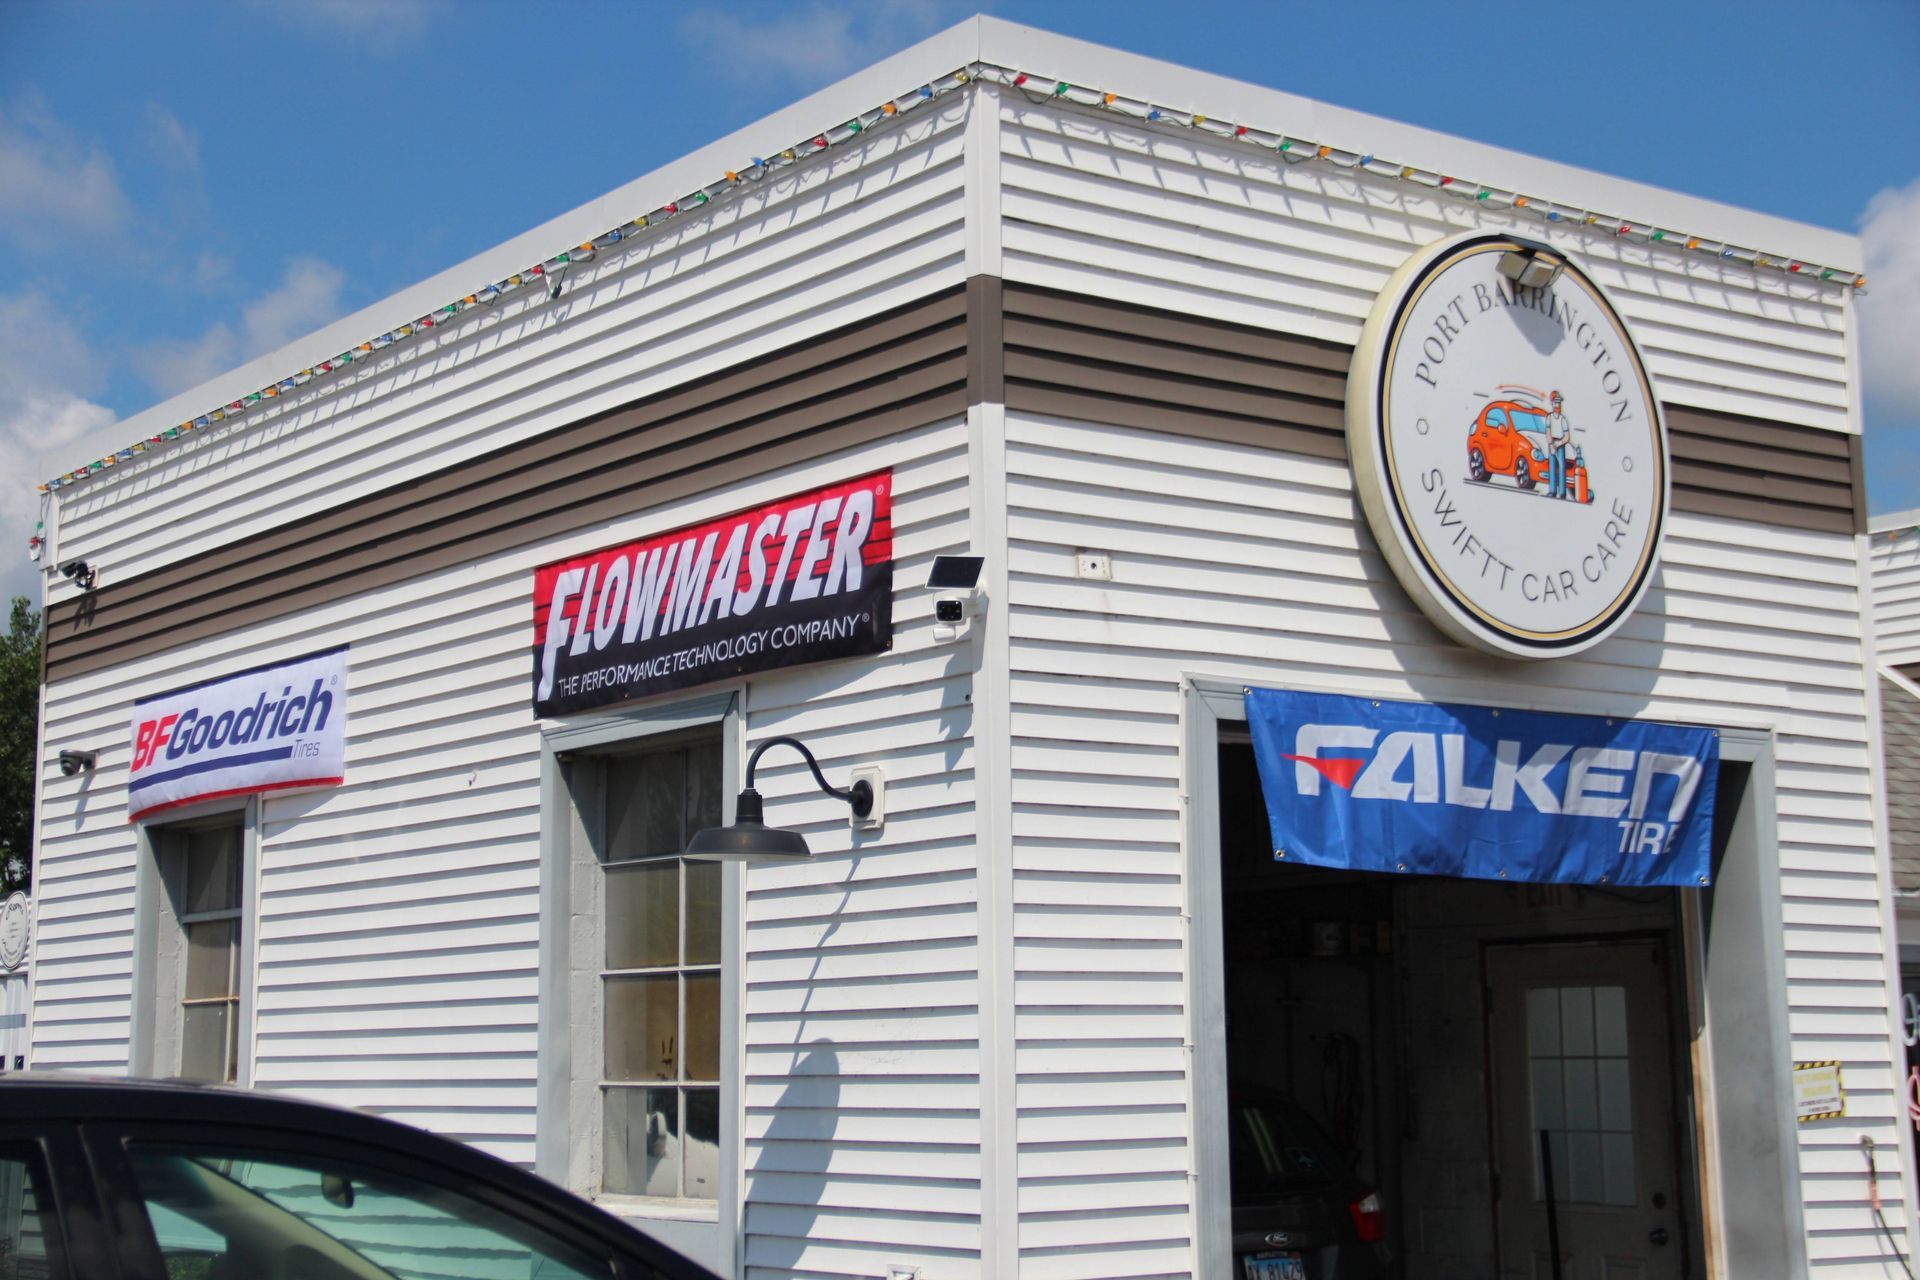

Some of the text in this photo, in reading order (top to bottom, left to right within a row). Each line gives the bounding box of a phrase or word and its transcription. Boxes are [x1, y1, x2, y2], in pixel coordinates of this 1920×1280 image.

[1415, 277, 1632, 424] PORT BARRINGTON
[1421, 468, 1633, 603] SWIFTT CAR CARE
[537, 489, 875, 701] FLOWMASTER
[558, 613, 860, 698] THE PERFORMANCE TECHNOLOGY COMPANY
[292, 738, 321, 760] Tires
[1294, 723, 1703, 822] FALKEN
